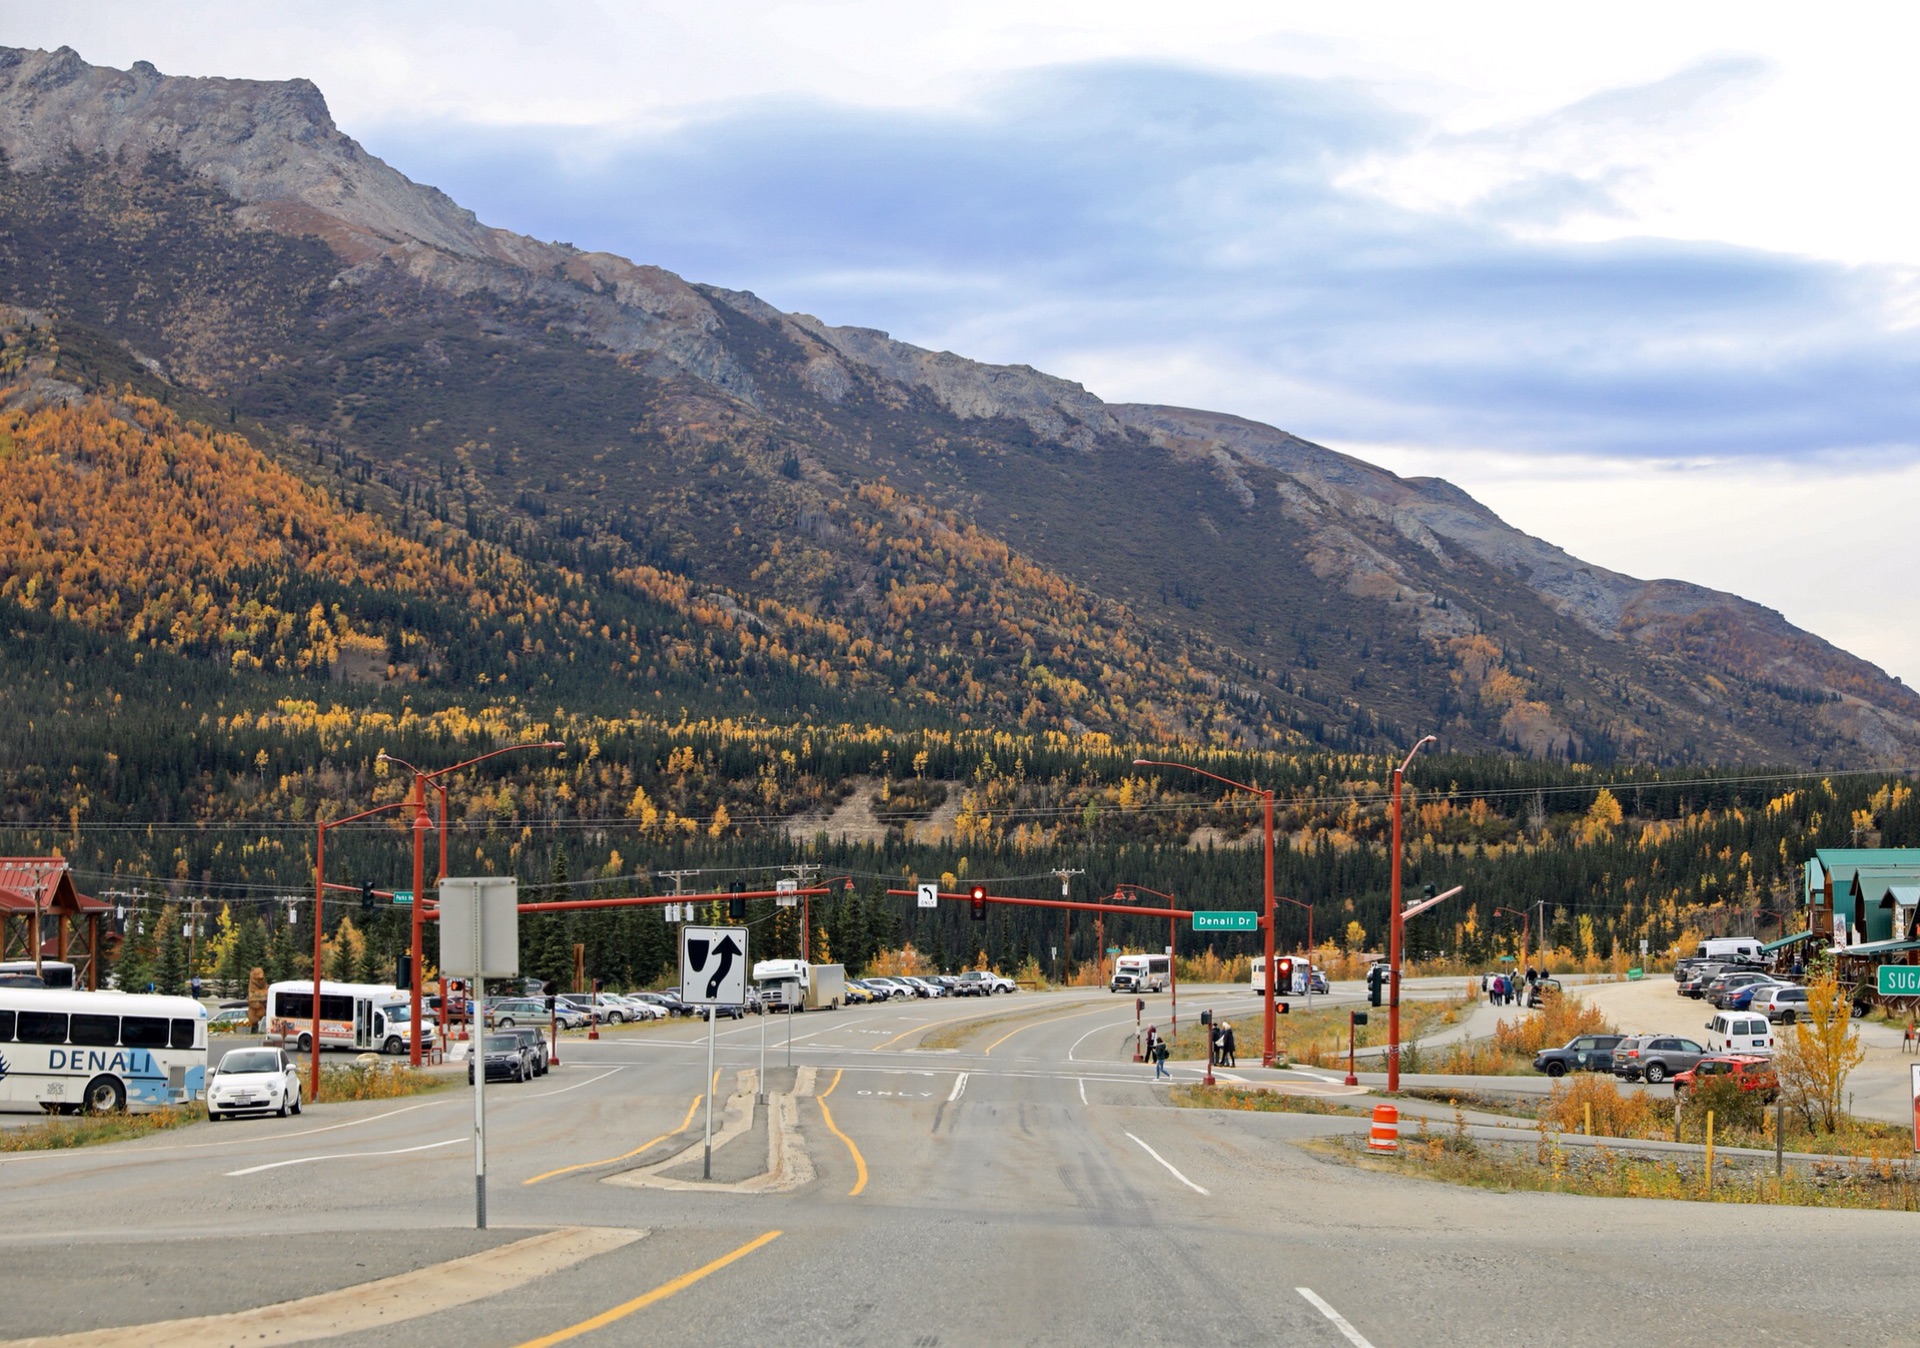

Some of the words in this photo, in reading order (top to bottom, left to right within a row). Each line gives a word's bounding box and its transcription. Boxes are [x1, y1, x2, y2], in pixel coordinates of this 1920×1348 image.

[1199, 916, 1233, 925] Denali
[1238, 916, 1251, 925] Dr
[49, 1049, 152, 1073] DENALI
